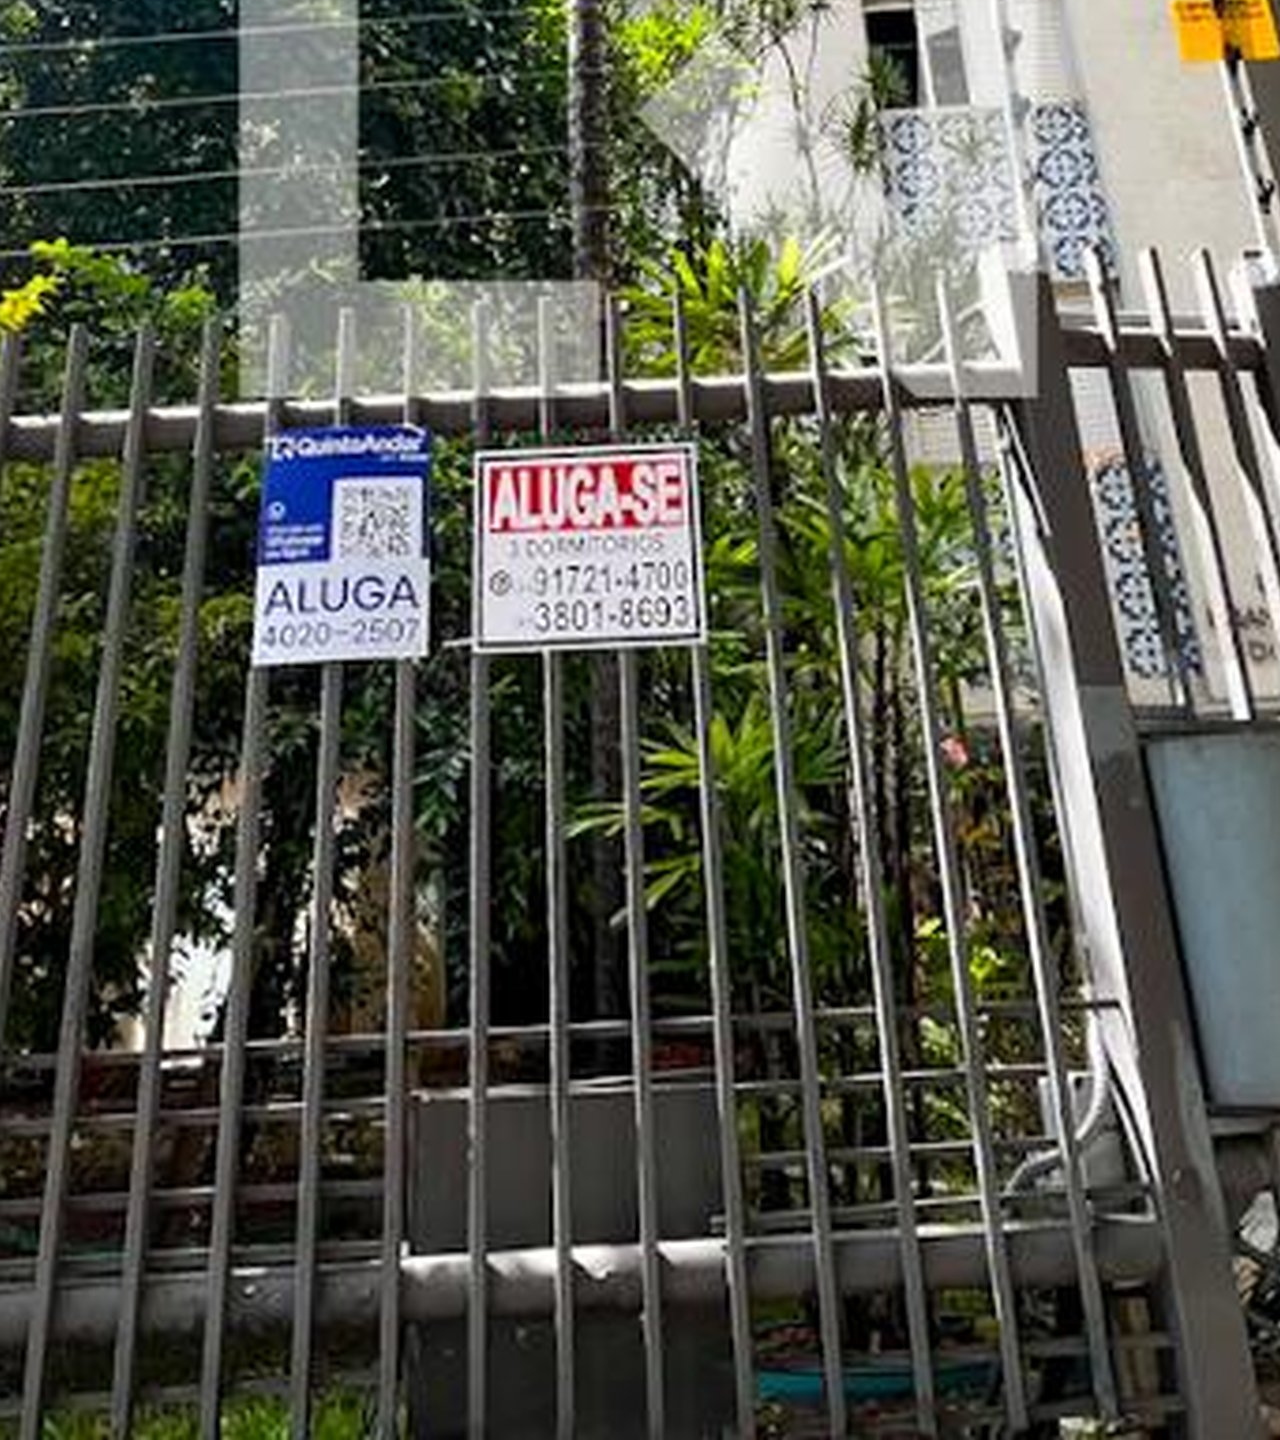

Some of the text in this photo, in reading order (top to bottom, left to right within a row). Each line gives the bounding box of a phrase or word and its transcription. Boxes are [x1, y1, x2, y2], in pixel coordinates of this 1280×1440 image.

[490, 463, 684, 530] ALUGA-SE
[263, 574, 420, 616] ALUGA
[534, 595, 690, 633] 3801-8693
[262, 617, 420, 648] 4020-2507
